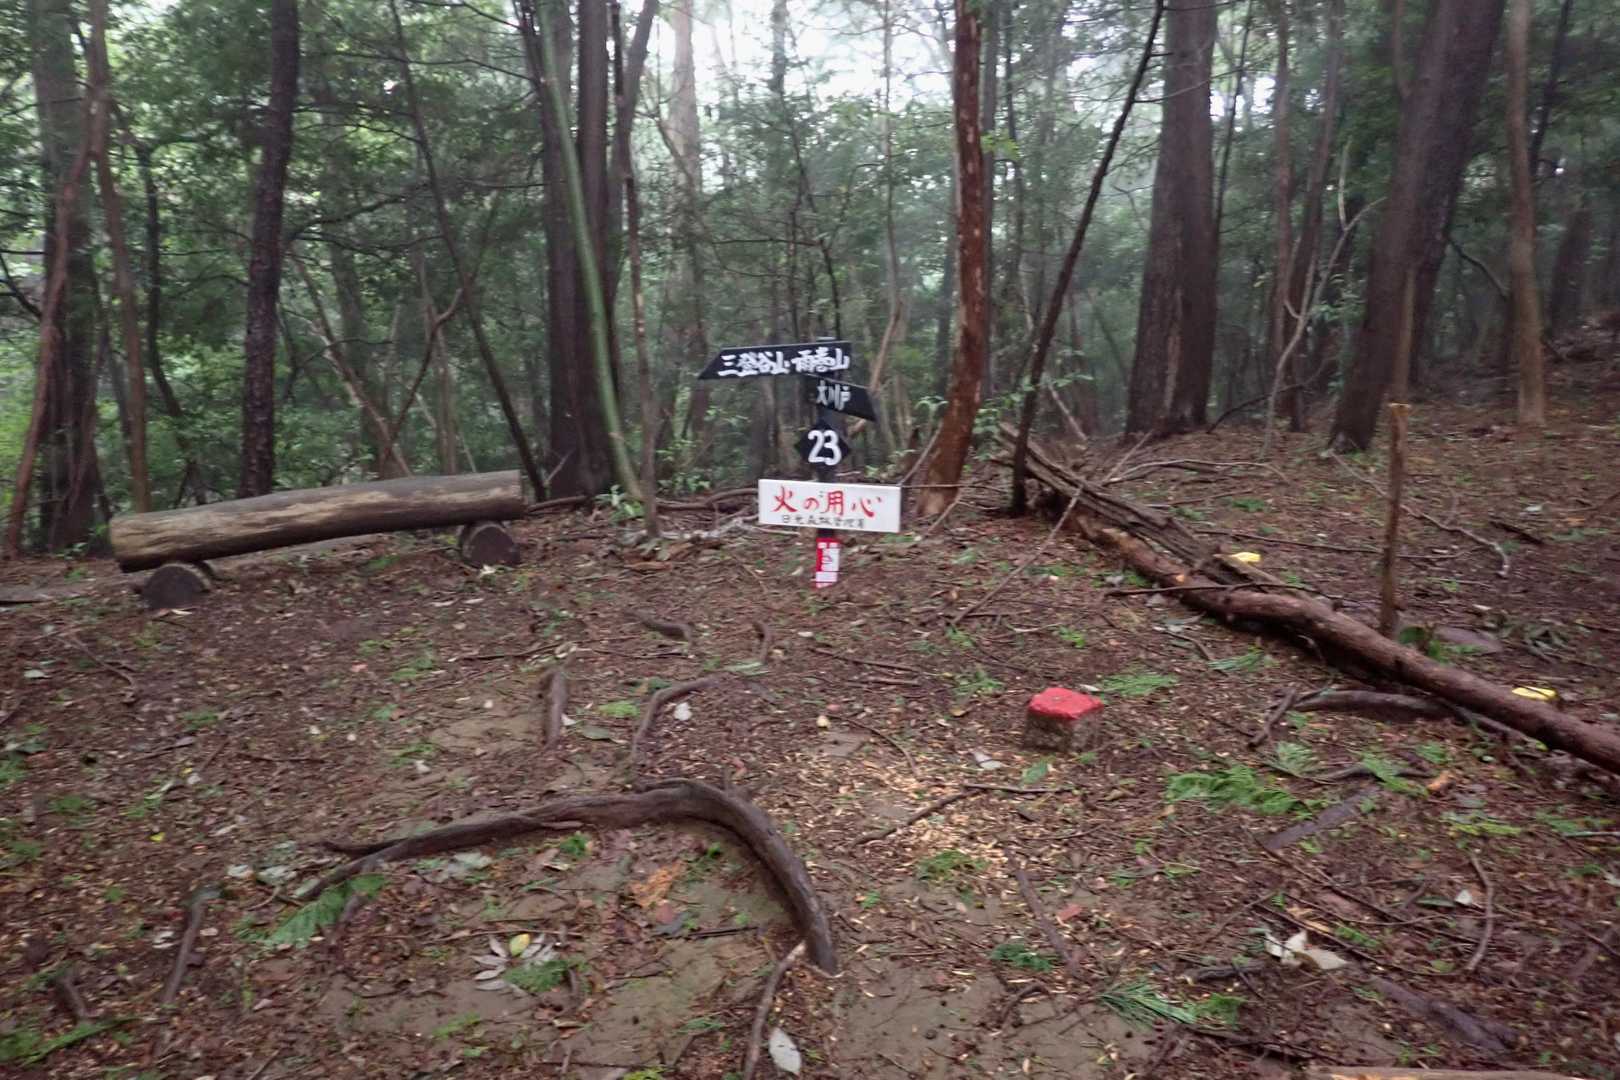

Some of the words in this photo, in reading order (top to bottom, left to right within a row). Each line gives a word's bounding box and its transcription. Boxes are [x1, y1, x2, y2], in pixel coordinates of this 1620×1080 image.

[807, 429, 842, 466] 23
[772, 485, 882, 518] 火の用心
